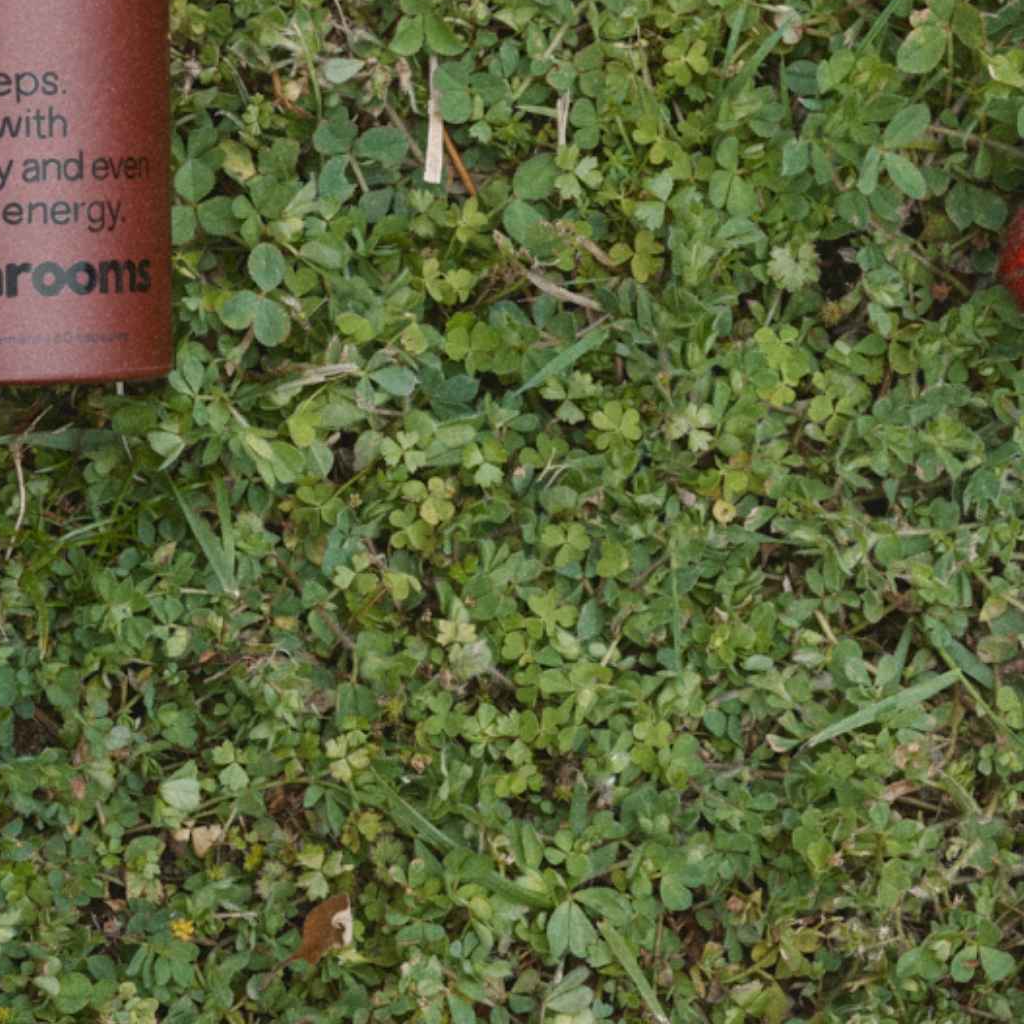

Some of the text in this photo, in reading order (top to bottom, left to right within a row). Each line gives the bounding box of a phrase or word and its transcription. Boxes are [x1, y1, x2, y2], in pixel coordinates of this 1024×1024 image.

[22, 150, 84, 182] and
[91, 155, 150, 181] even
[1, 200, 126, 232] energy.
